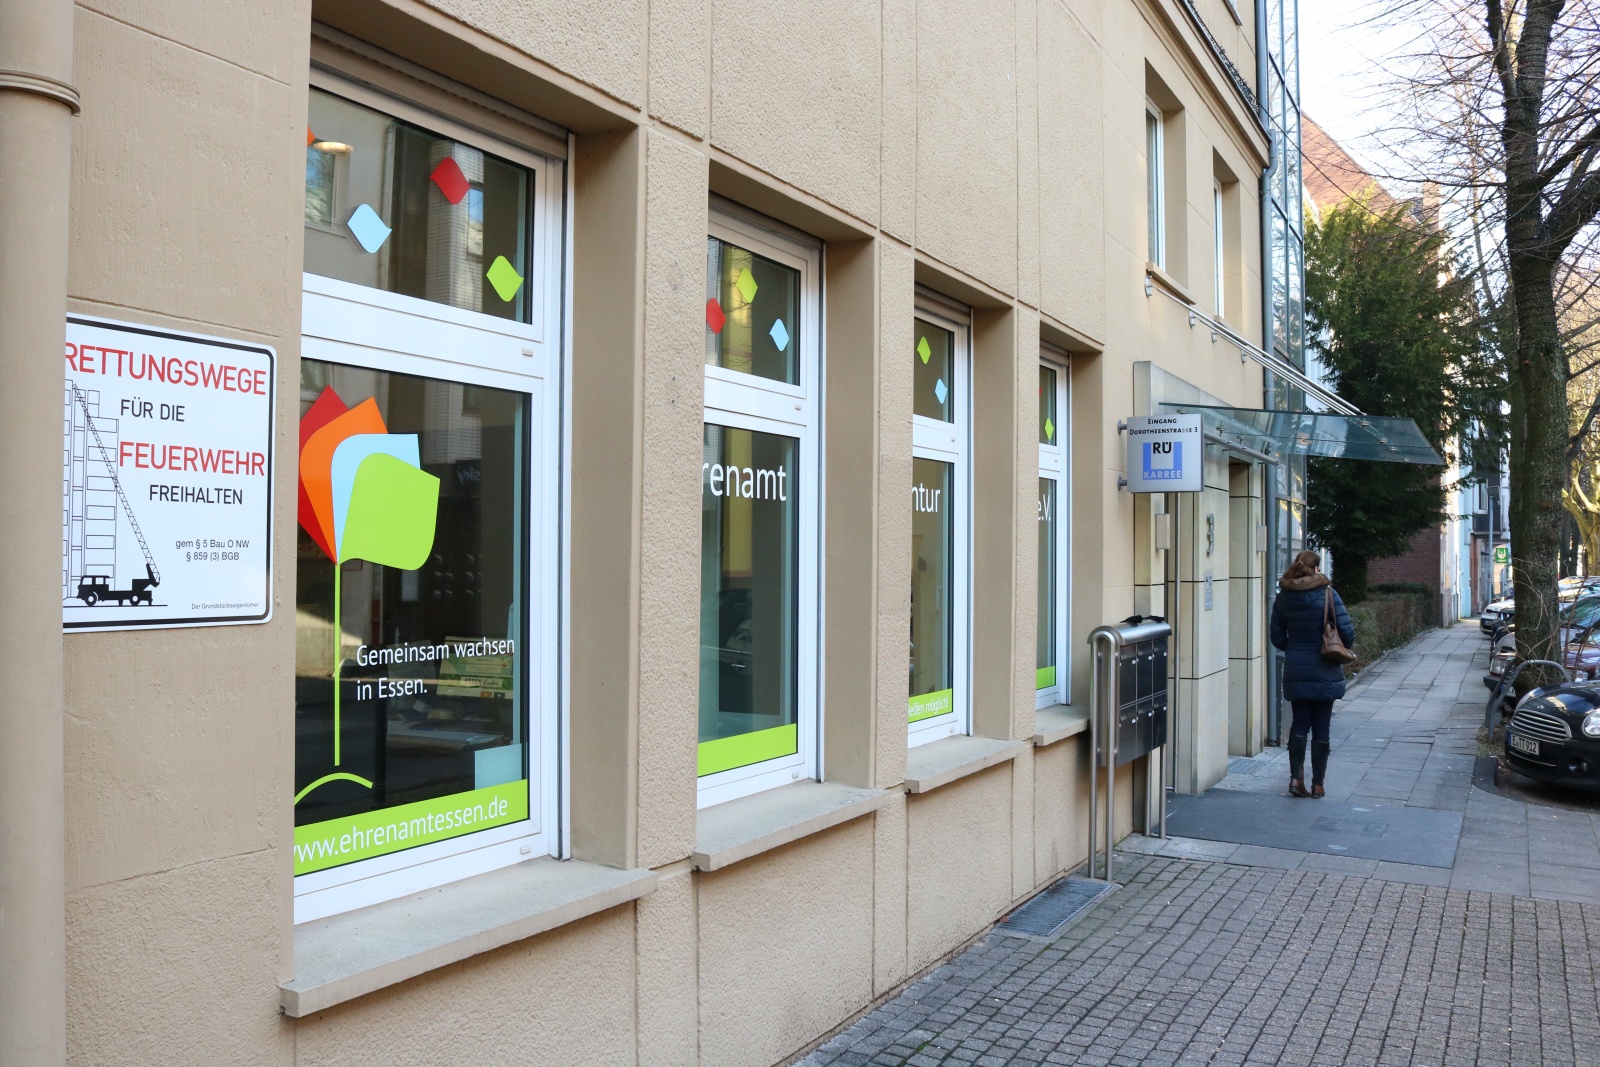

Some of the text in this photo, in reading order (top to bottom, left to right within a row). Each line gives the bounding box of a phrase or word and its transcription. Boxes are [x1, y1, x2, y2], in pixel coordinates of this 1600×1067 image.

[66, 342, 267, 395] RETTUNGSWEGE
[120, 397, 185, 422] FÜR DIE
[119, 441, 265, 476] FEUERWEHR
[1153, 441, 1172, 454] RÜ
[1143, 470, 1182, 479] KARREE
[149, 485, 243, 505] FREIHALTEN
[175, 540, 194, 549] gem
[202, 540, 208, 548] 5
[210, 539, 225, 548] Bau
[235, 540, 249, 548] NW
[193, 552, 208, 560] 859
[210, 551, 220, 562] (3)
[221, 552, 240, 560] BGB
[356, 636, 515, 666] Gemeinsam wachsen
[356, 677, 428, 701] in Essen.
[294, 796, 508, 863] ww.ehrenamtessen.de
